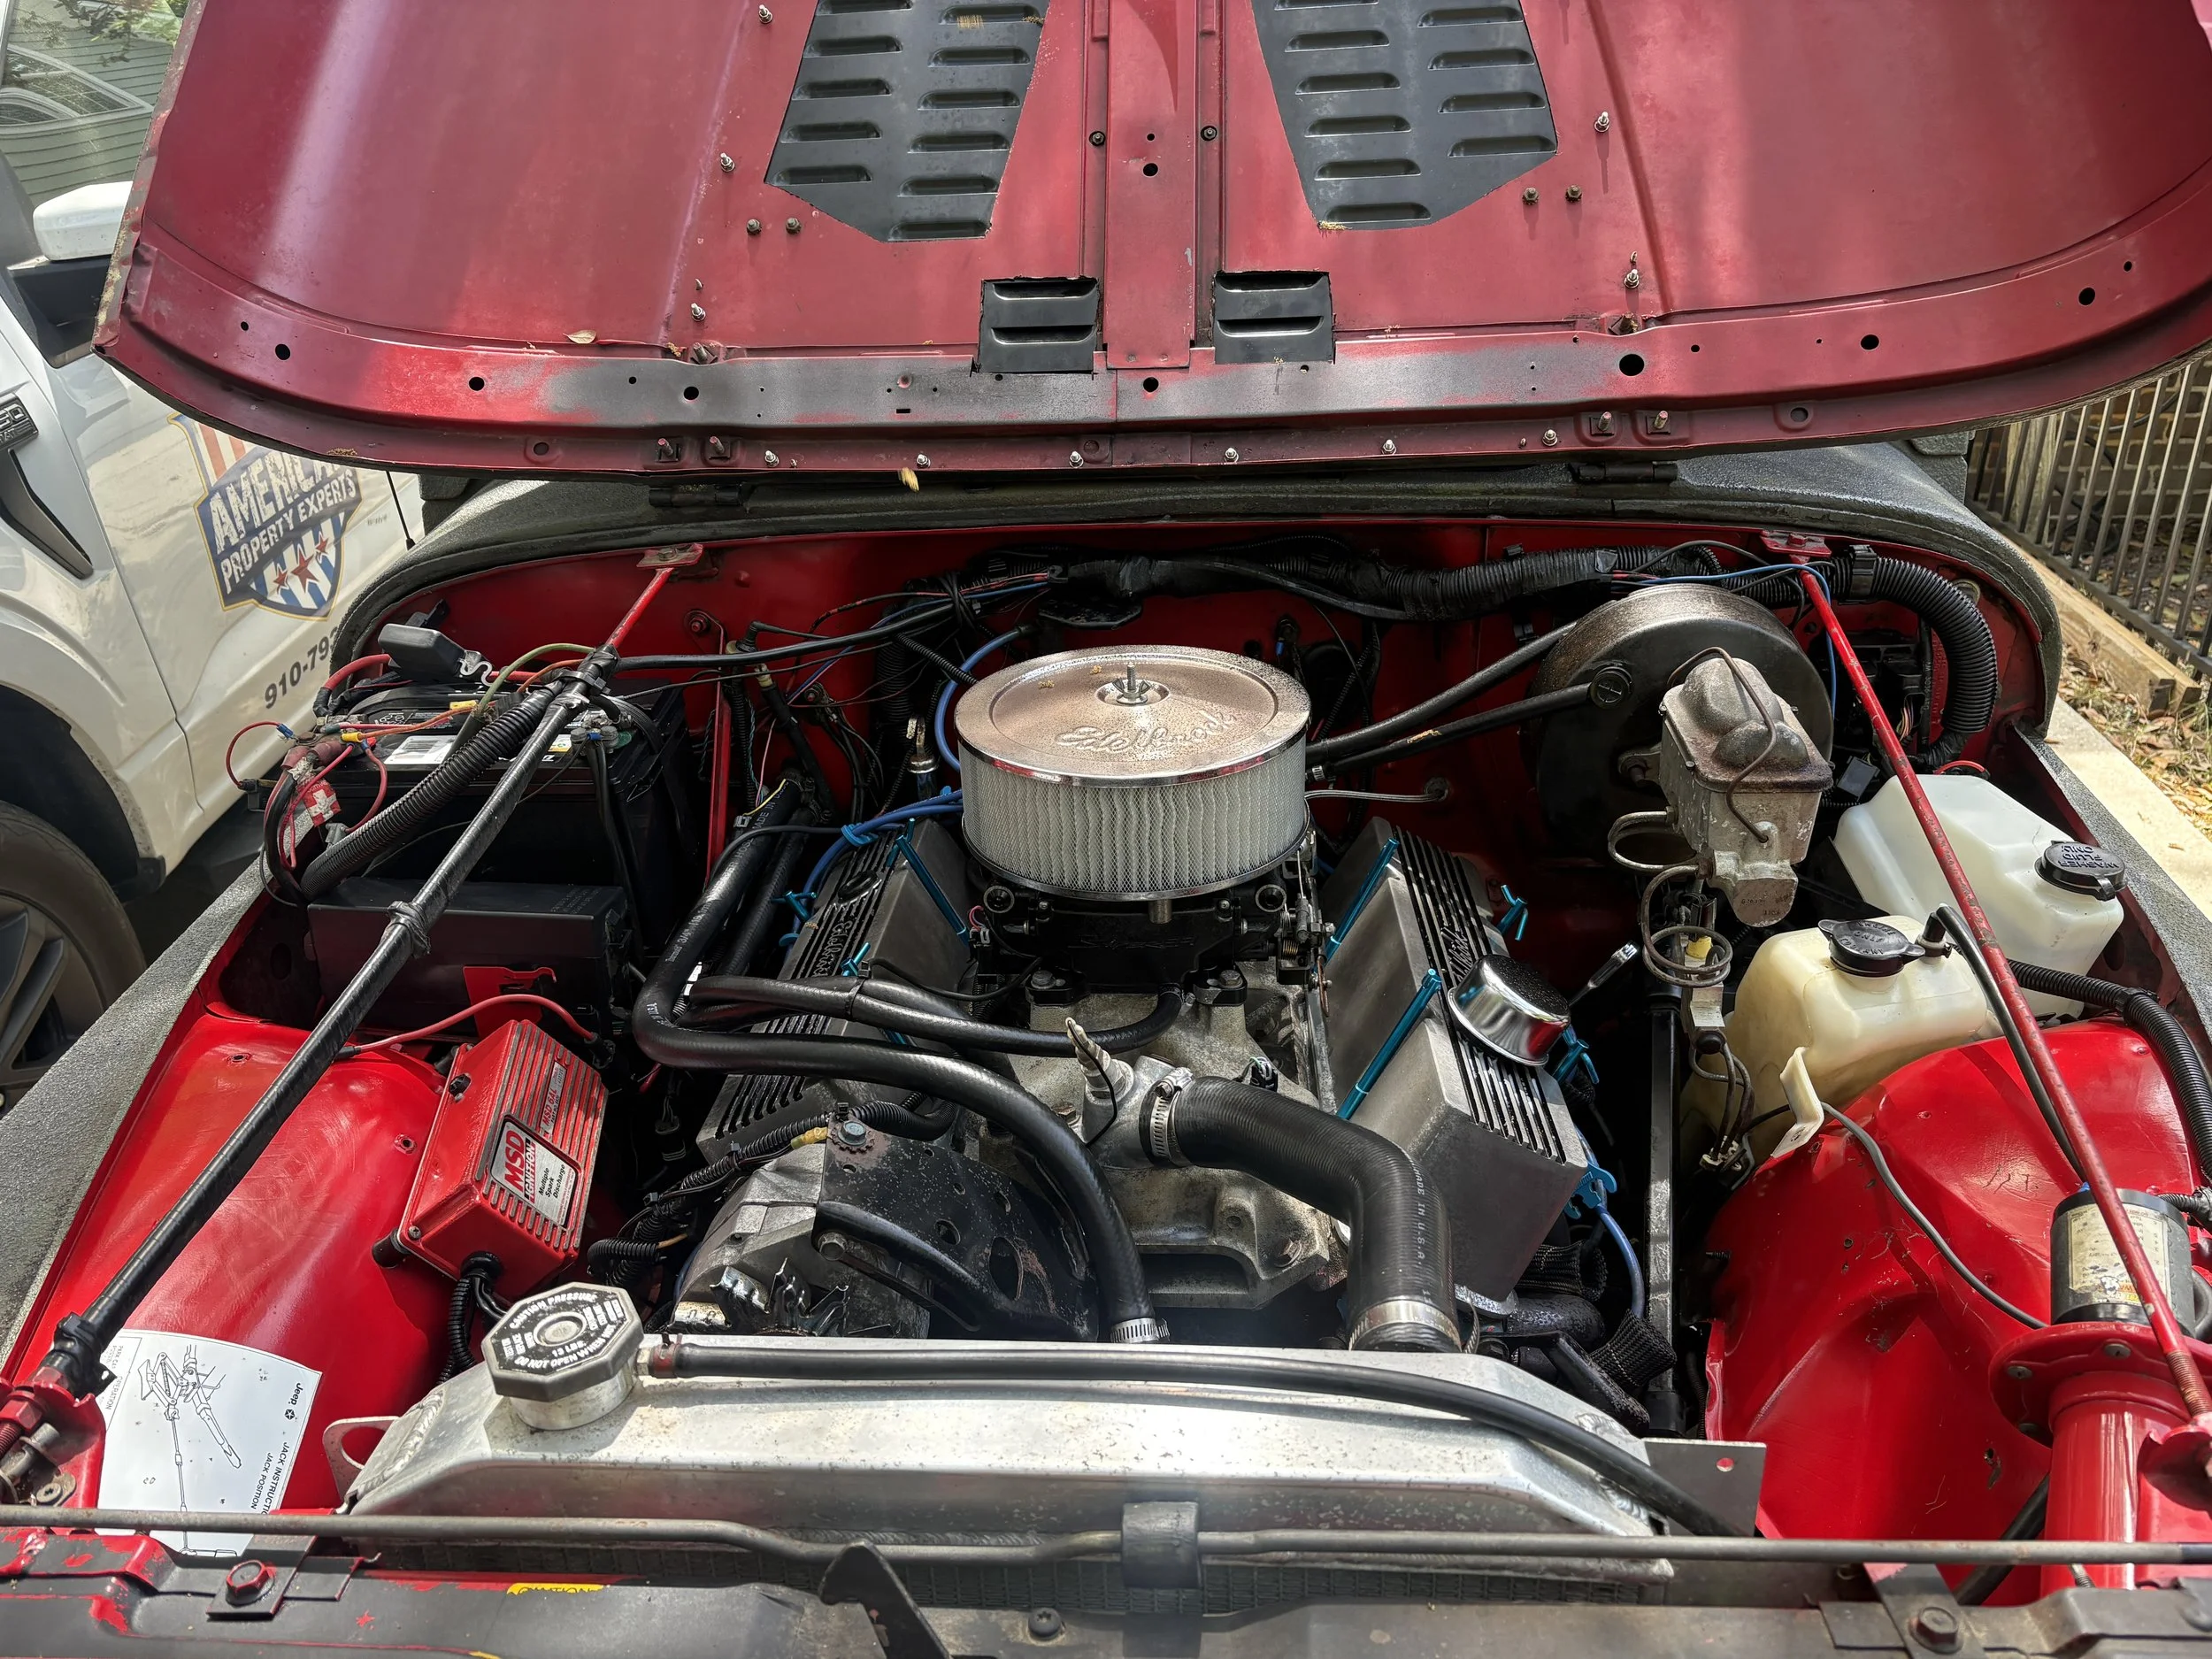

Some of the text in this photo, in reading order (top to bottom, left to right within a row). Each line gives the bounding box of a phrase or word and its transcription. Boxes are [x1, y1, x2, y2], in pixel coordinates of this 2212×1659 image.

[220, 468, 357, 594] PROPERTY EXPERTS
[1055, 710, 1239, 754] Edelbrock
[2057, 859, 2119, 869] WASHER
[2061, 845, 2094, 854] ONLY
[2062, 853, 2103, 862] FLUID
[1854, 930, 1885, 943] ONLY
[1856, 921, 1897, 936] ENGINE
[542, 1105, 553, 1125] MSD
[548, 1087, 557, 1104] 6AL
[504, 1130, 525, 1193] MSD
[525, 1142, 536, 1202] IGNITION
[538, 1167, 550, 1196] Multiple
[545, 1176, 555, 1198] Spark
[553, 1164, 566, 1199] Discharge
[1412, 1166, 1425, 1266] MADE IN U.S.A.
[509, 1292, 598, 1330] CAUTION PRESSURE
[514, 1356, 530, 1366] DO
[527, 1358, 550, 1370] NOT
[550, 1353, 579, 1368] OPEN
[577, 1337, 606, 1357] WHEN
[551, 1348, 565, 1357] 13
[105, 1376, 124, 1410] OPERATION
[278, 1441, 290, 1465] JACK
[250, 1452, 273, 1509] JACK POSITION
